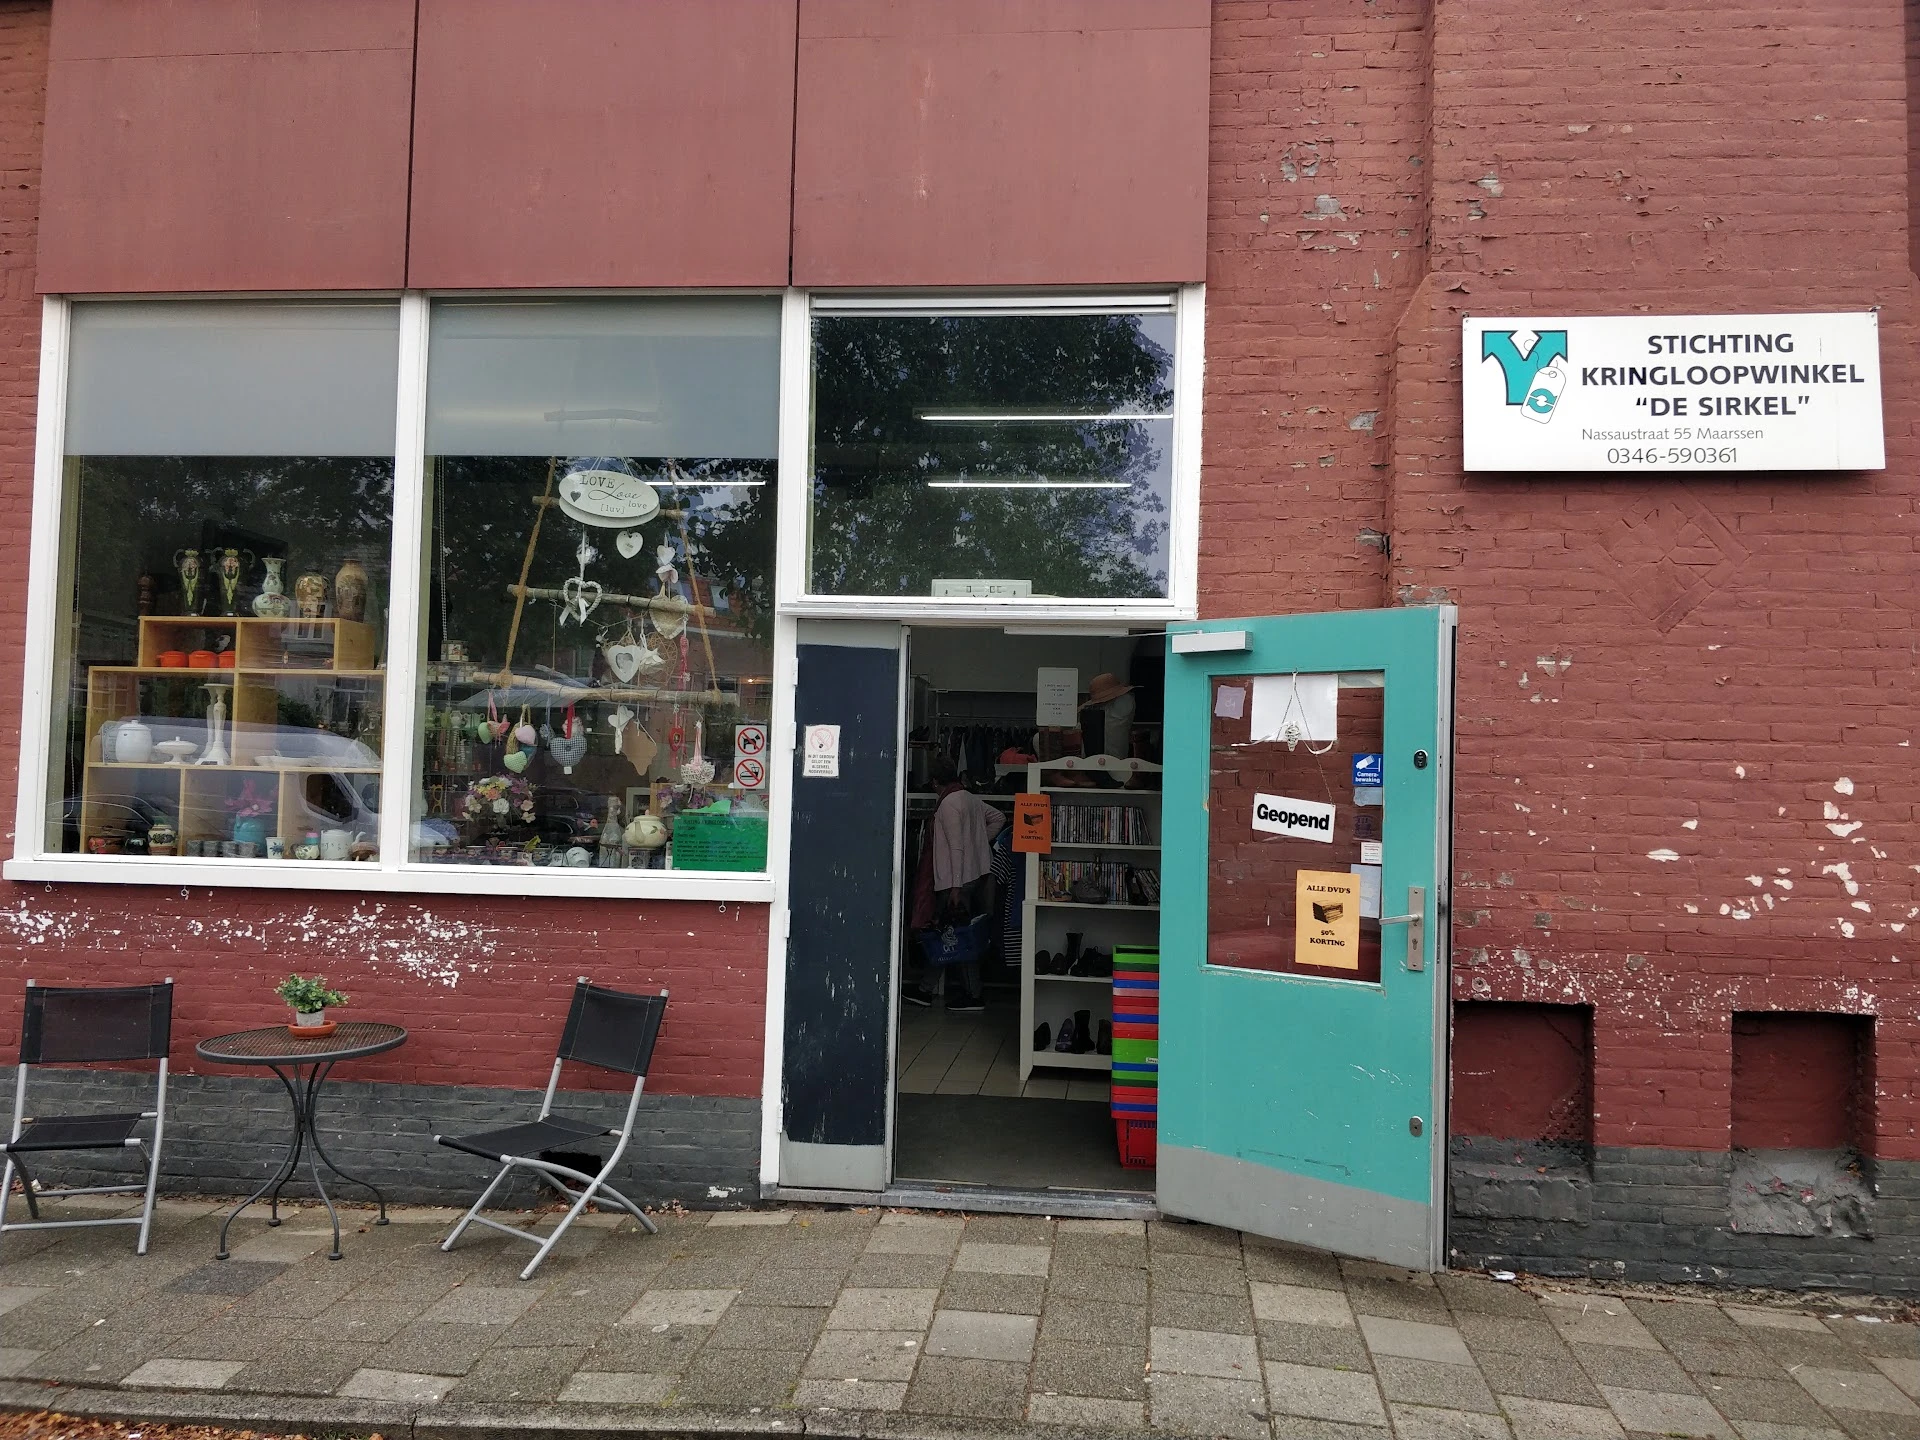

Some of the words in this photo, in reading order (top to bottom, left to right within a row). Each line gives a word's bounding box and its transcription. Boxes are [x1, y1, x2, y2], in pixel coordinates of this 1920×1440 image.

[1648, 333, 1794, 355] STICHTING
[1581, 364, 1865, 386] KRINGLOOPWINKEL
[1636, 396, 1688, 417] “DE
[1698, 395, 1810, 416] SIRKEL”
[1581, 428, 1670, 441] Nassaustraat
[1673, 428, 1692, 440] 55
[1696, 427, 1764, 440] Maarssen
[1607, 447, 1738, 464] 0346-590361
[579, 474, 616, 489] LOVE
[588, 483, 642, 501] Love
[600, 503, 626, 515] [luv]
[628, 500, 648, 510] love
[1355, 776, 1381, 784] bewaking
[1256, 803, 1330, 831] Geopend
[1306, 884, 1326, 892] ALLE
[1327, 886, 1351, 894] DVD'S
[1309, 937, 1345, 947] KORTING
